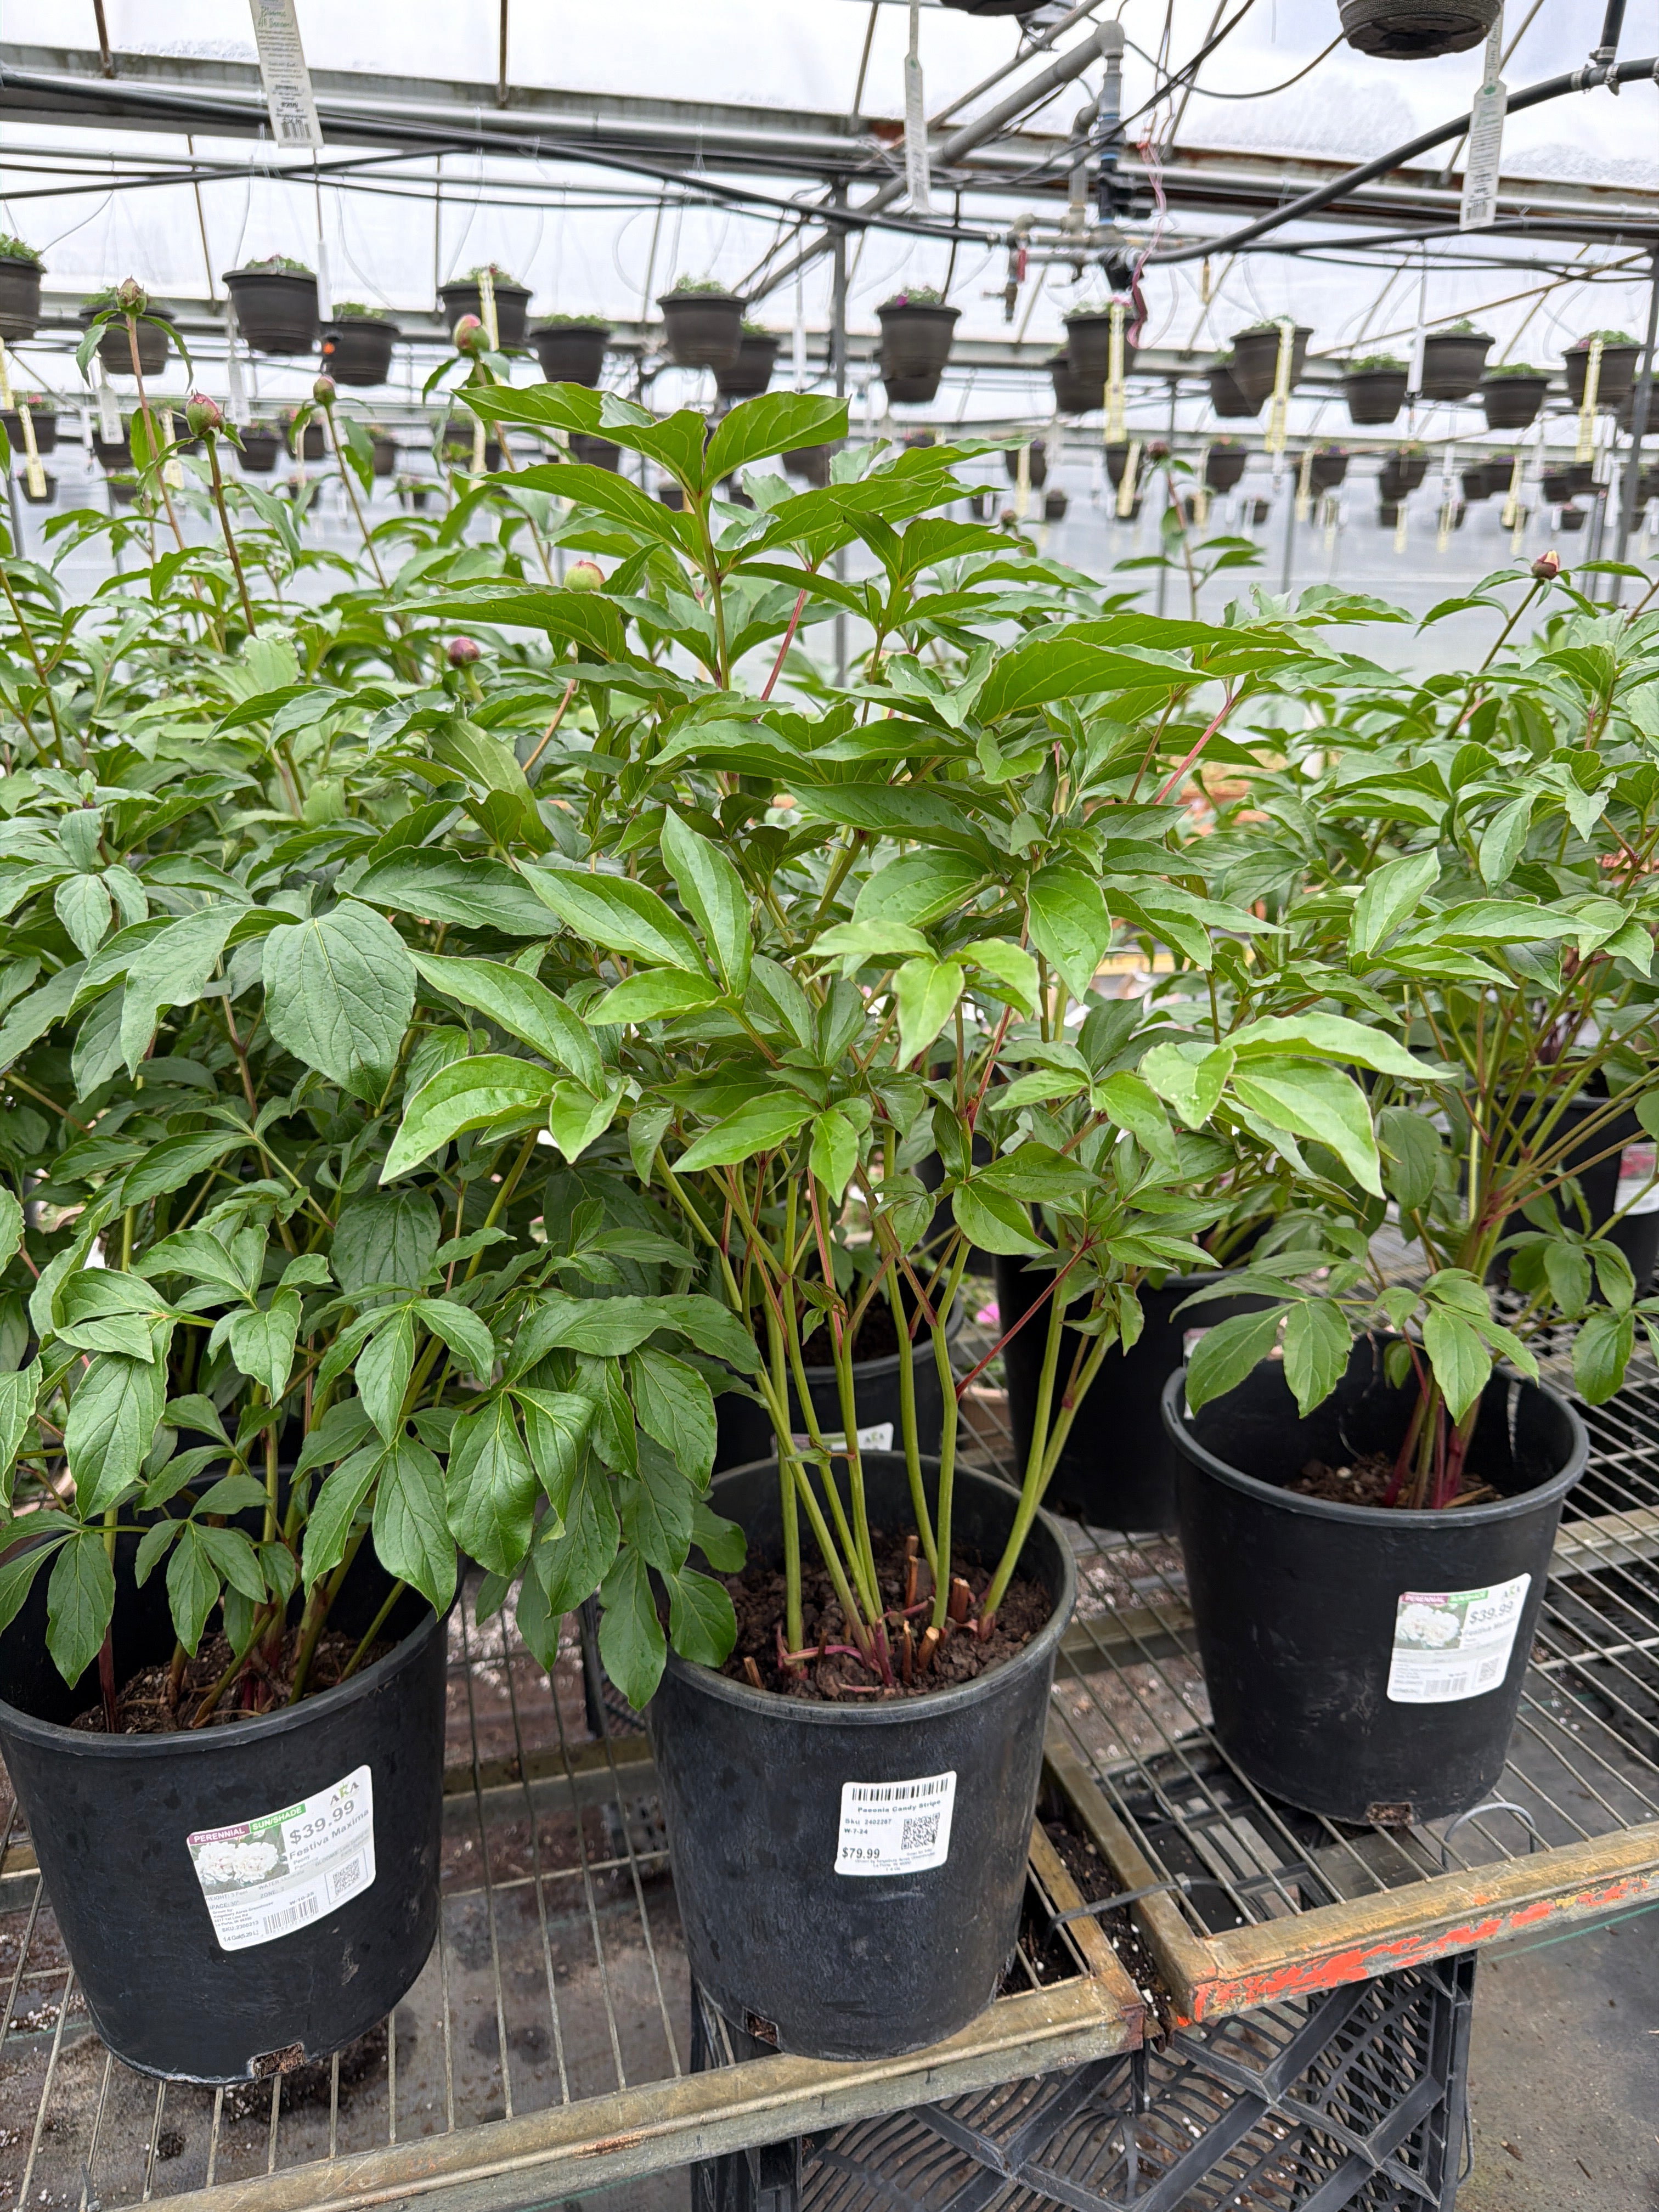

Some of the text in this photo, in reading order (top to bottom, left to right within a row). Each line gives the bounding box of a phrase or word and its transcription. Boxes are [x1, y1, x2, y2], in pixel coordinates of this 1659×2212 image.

[290, 1799, 354, 1844] $39.99
[918, 1799, 941, 1808] Stripe
[194, 1806, 302, 1842] PERENNIAL SUN/SHADE
[290, 1809, 369, 1859] Festiva Maxima
[842, 1847, 880, 1859] $79.99
